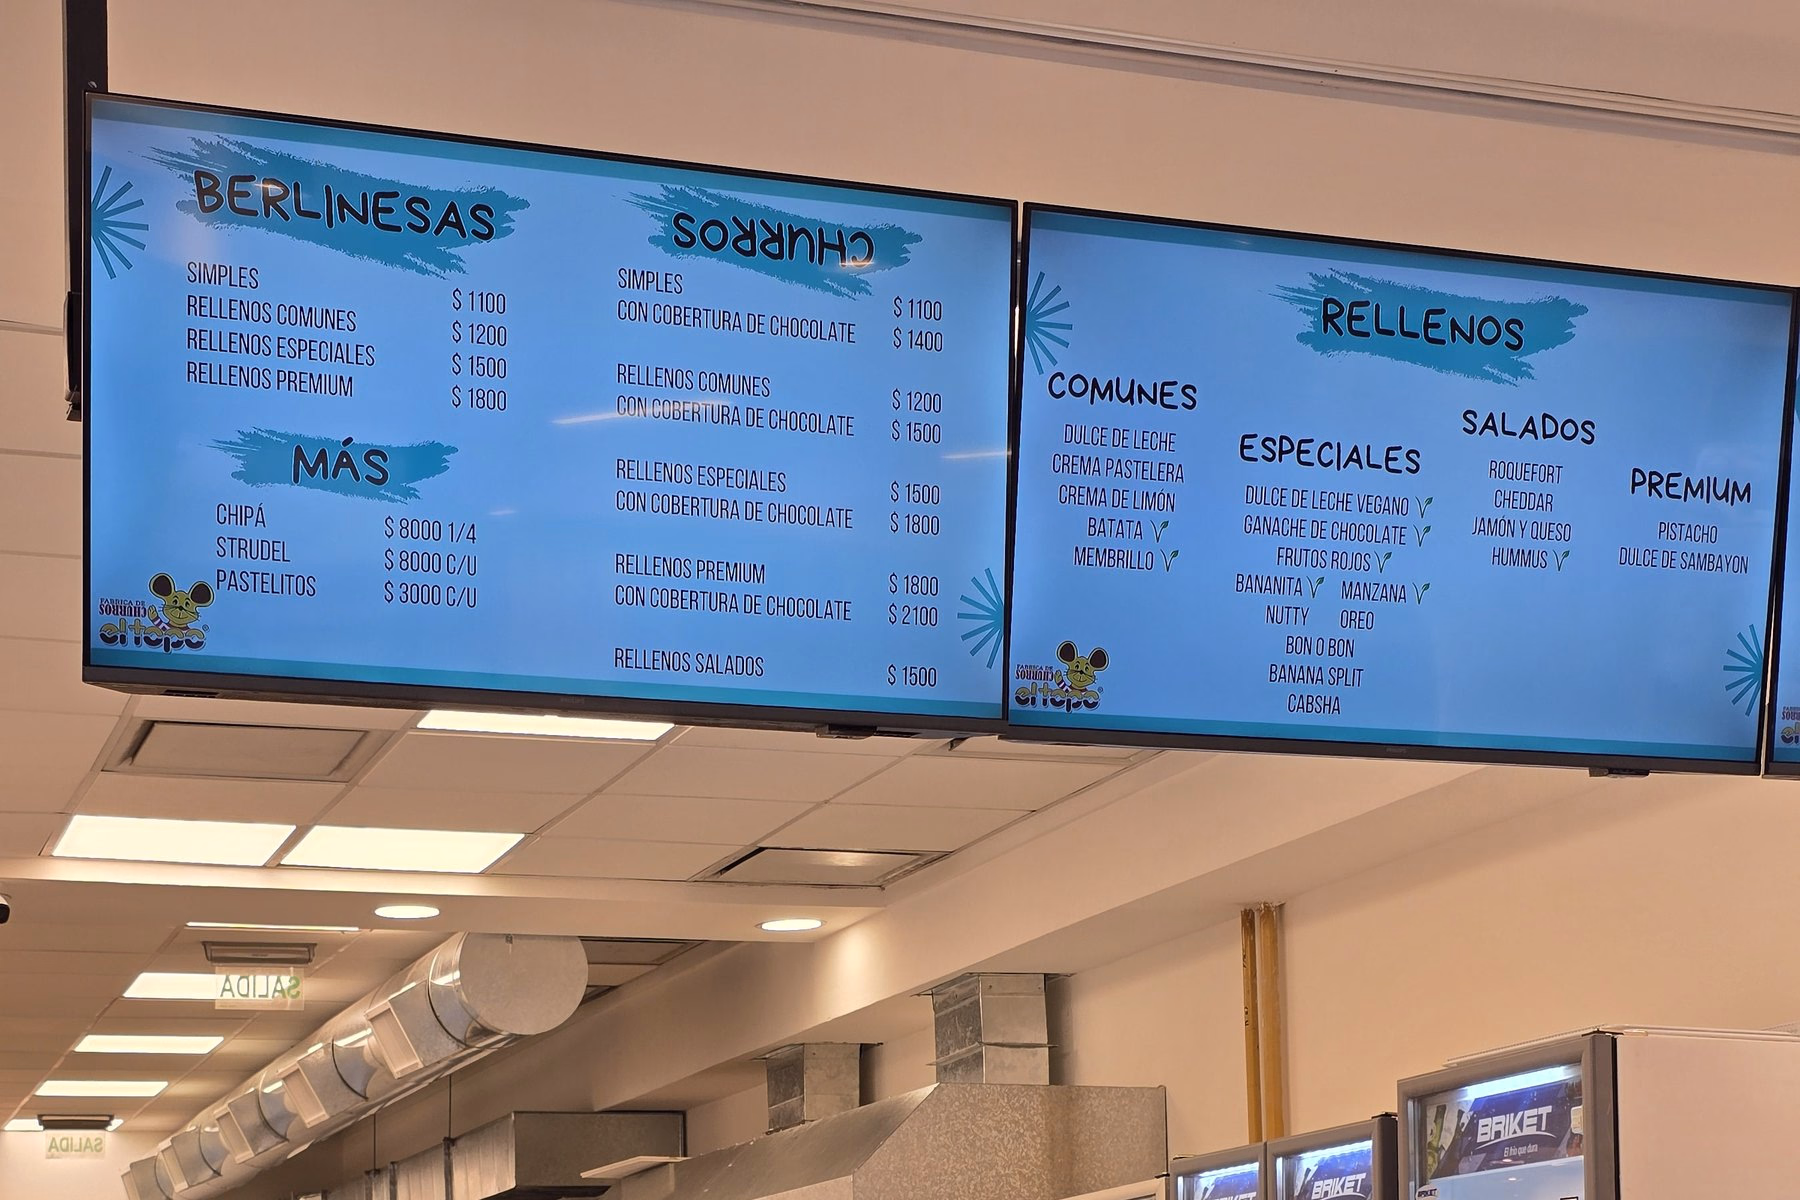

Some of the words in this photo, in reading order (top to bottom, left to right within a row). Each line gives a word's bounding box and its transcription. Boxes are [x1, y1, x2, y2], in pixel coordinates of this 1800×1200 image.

[193, 170, 496, 241] BERLINESAS
[672, 212, 874, 269] CHURROS
[187, 261, 259, 290] SIMPLES
[618, 267, 683, 295] SIMPLES
[187, 294, 272, 324] RELLENOS
[277, 303, 357, 332] COMUNES
[452, 287, 462, 312] $
[468, 290, 506, 315] 1100
[893, 295, 903, 318] $
[908, 298, 942, 322] 1100
[452, 319, 462, 344] $
[468, 322, 507, 347] 1200
[617, 299, 648, 323] CON
[652, 303, 742, 332] COBERTURA
[747, 312, 766, 335] DE
[770, 315, 856, 344] CHOCOLATE
[1322, 297, 1524, 352] RELLENOS
[187, 327, 272, 357] RELLENOS
[277, 336, 375, 367] ESPECIALES
[893, 326, 902, 350] $
[907, 329, 943, 353] 1400
[187, 360, 272, 390] RELLENOS
[276, 369, 353, 398] PREMIUM
[452, 352, 462, 376] $
[468, 355, 507, 379] 1500
[617, 363, 694, 391] RELLENOS
[698, 370, 771, 398] COMUNES
[1047, 371, 1197, 411] COMUNES
[451, 384, 462, 409] $
[467, 387, 507, 412] 1800
[892, 387, 901, 411] $
[906, 391, 942, 414] 1200
[617, 394, 647, 418] CON
[652, 398, 742, 426] COBERTURA
[745, 406, 765, 429] DE
[768, 408, 855, 437] CHOCOLATE
[1462, 409, 1596, 445] SALADOS
[891, 418, 901, 442] $
[906, 421, 941, 444] 1500
[1064, 423, 1109, 447] DULCE
[1111, 427, 1130, 449] DE
[1133, 429, 1177, 453] LECHE
[293, 436, 389, 486] MÁS
[1052, 453, 1101, 477] CREMA
[1105, 457, 1184, 483] PASTELERA
[1239, 433, 1421, 475] ESPECIALES
[616, 458, 693, 485] RELLENOS
[697, 465, 786, 493] ESPECIALES
[1489, 459, 1564, 484] ROQUEFORT
[890, 480, 900, 503] $
[905, 483, 940, 505] 1500
[1059, 484, 1108, 508] CREMA
[1111, 488, 1130, 509] DE
[1132, 489, 1176, 513] LIMÓN
[1245, 485, 1288, 507] DULCE
[1291, 488, 1309, 509] DE
[1311, 490, 1354, 512] LECHE
[1357, 493, 1409, 517] VEGANO
[1494, 489, 1554, 512] CHEDDAR
[1631, 467, 1751, 507] PREMIUM
[216, 502, 266, 528] CHIPÁ
[616, 489, 646, 513] CON
[651, 492, 740, 520] COBERTURA
[744, 500, 764, 522] DE
[767, 502, 854, 529] CHOCOLATE
[890, 510, 899, 534] $
[904, 513, 940, 536] 1800
[384, 515, 395, 539] $
[399, 517, 442, 542] 8000
[448, 521, 477, 545] 1/4
[1087, 516, 1143, 540] BATATA
[1243, 514, 1308, 538] GANACHE
[1310, 519, 1328, 540] DE
[1330, 521, 1408, 546] CHOCOLATE
[1471, 515, 1516, 538] JAMÓN
[1519, 519, 1528, 539] Y
[1530, 520, 1572, 543] QUESO
[1658, 521, 1718, 544] PISTACHO
[216, 535, 291, 563] STRUDEL
[384, 547, 394, 572] $
[399, 550, 442, 574] 8000
[446, 553, 477, 577] C/U
[1074, 545, 1154, 571] MEMBRILLO
[1276, 546, 1328, 569] FRUTOS
[1330, 550, 1371, 572] ROJOS
[1491, 546, 1548, 569] HUMMUS
[1619, 546, 1659, 568] DULCE
[1661, 550, 1678, 569] DE
[1679, 551, 1749, 574] SAMBAYON
[216, 568, 316, 597] PASTELITOS
[615, 553, 692, 579] RELLENOS
[696, 559, 765, 585] PREMIUM
[384, 579, 394, 604] $
[399, 582, 441, 606] 3000
[446, 585, 477, 609] C/U
[889, 571, 898, 595] $
[903, 574, 939, 597] 1800
[1235, 573, 1303, 597] BANANITA
[1341, 580, 1407, 604] MANZANA
[615, 584, 645, 607] CON
[650, 587, 739, 614] COBERTURA
[743, 593, 762, 615] DE
[766, 595, 852, 621] CHOCOLATE
[888, 602, 898, 626] $
[901, 604, 938, 627] 2100
[1266, 604, 1310, 626] NUTTY
[1339, 609, 1375, 630] OREO
[1285, 635, 1313, 656] BON
[1315, 637, 1325, 657] O
[1327, 637, 1355, 658] BON
[614, 647, 691, 673] RELLENOS
[695, 652, 764, 677] SALADOS
[887, 663, 897, 686] $
[902, 665, 937, 688] 1500
[1269, 663, 1324, 686] BANANA
[1327, 666, 1364, 688] SPLIT
[1287, 693, 1341, 715] CABSHA
[1476, 1105, 1553, 1143] BRIKET
[1311, 1172, 1367, 1200] BRIKET
